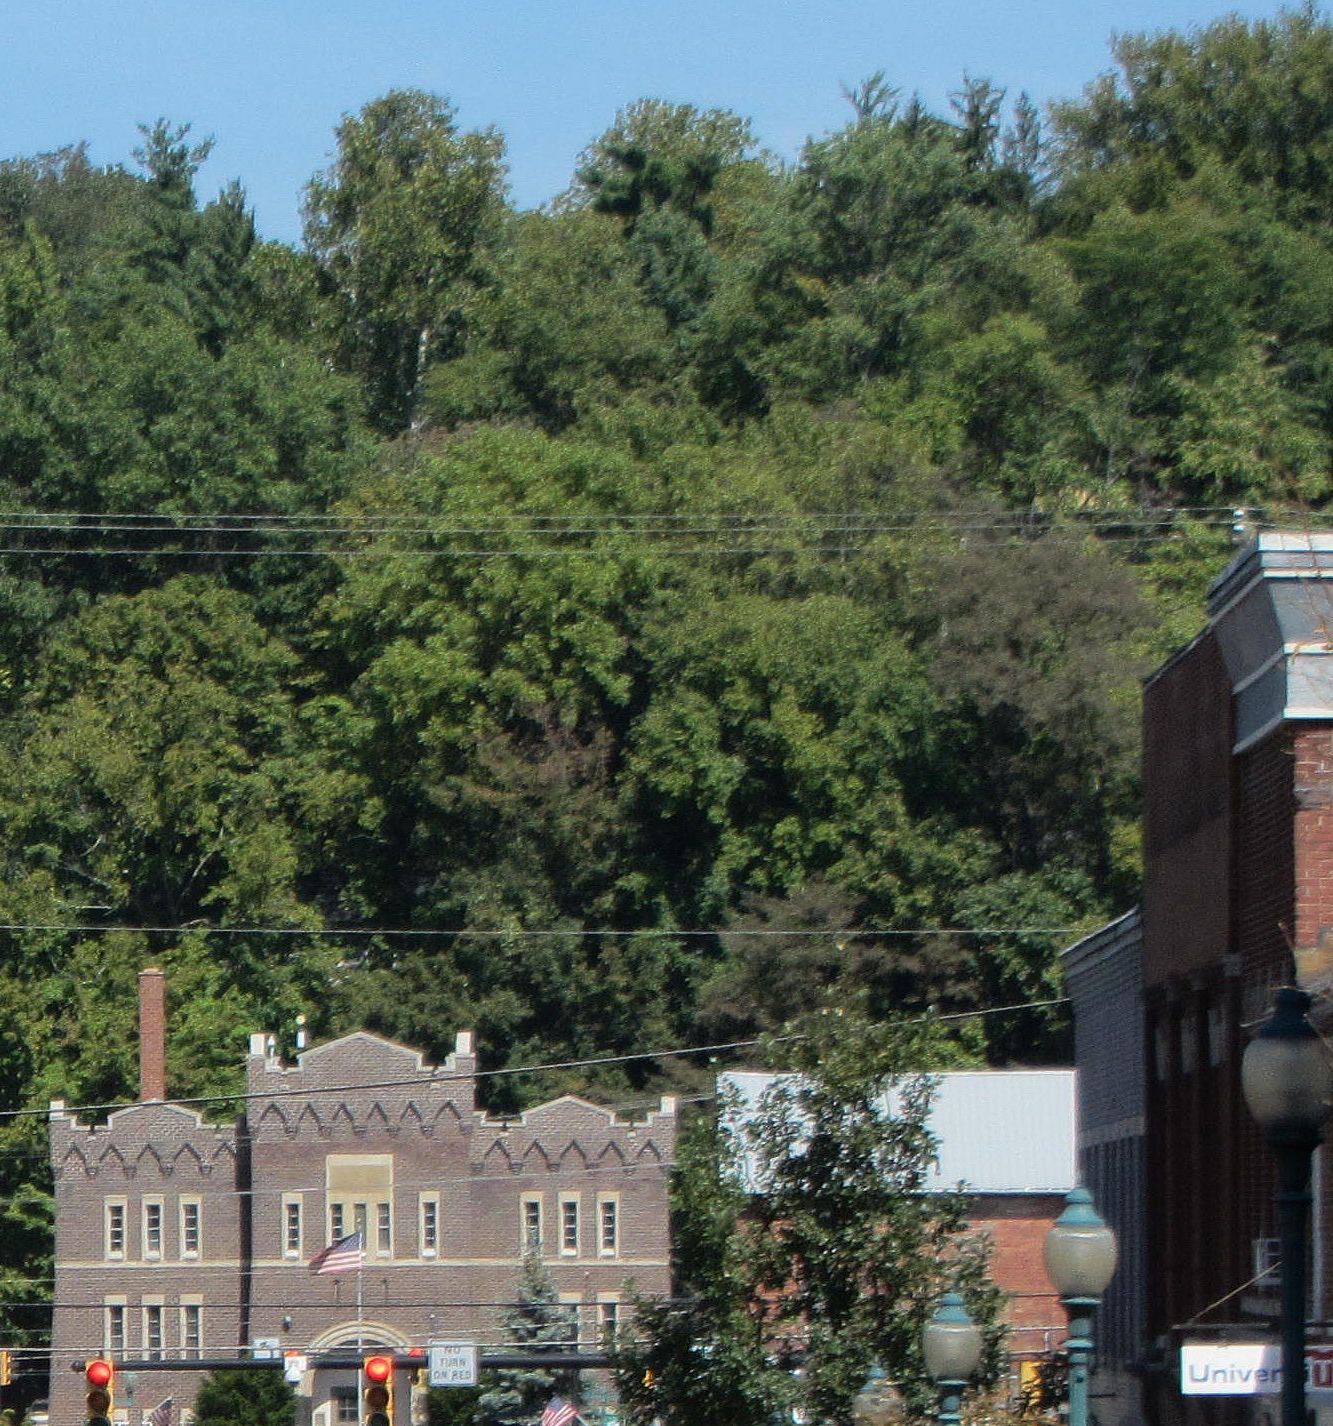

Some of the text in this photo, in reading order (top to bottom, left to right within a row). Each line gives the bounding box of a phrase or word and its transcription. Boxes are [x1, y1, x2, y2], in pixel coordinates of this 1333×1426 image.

[444, 1346, 461, 1354] NO
[440, 1358, 466, 1367] TURN
[434, 1370, 471, 1380] ON RED
[1189, 1363, 1283, 1383] Univer
